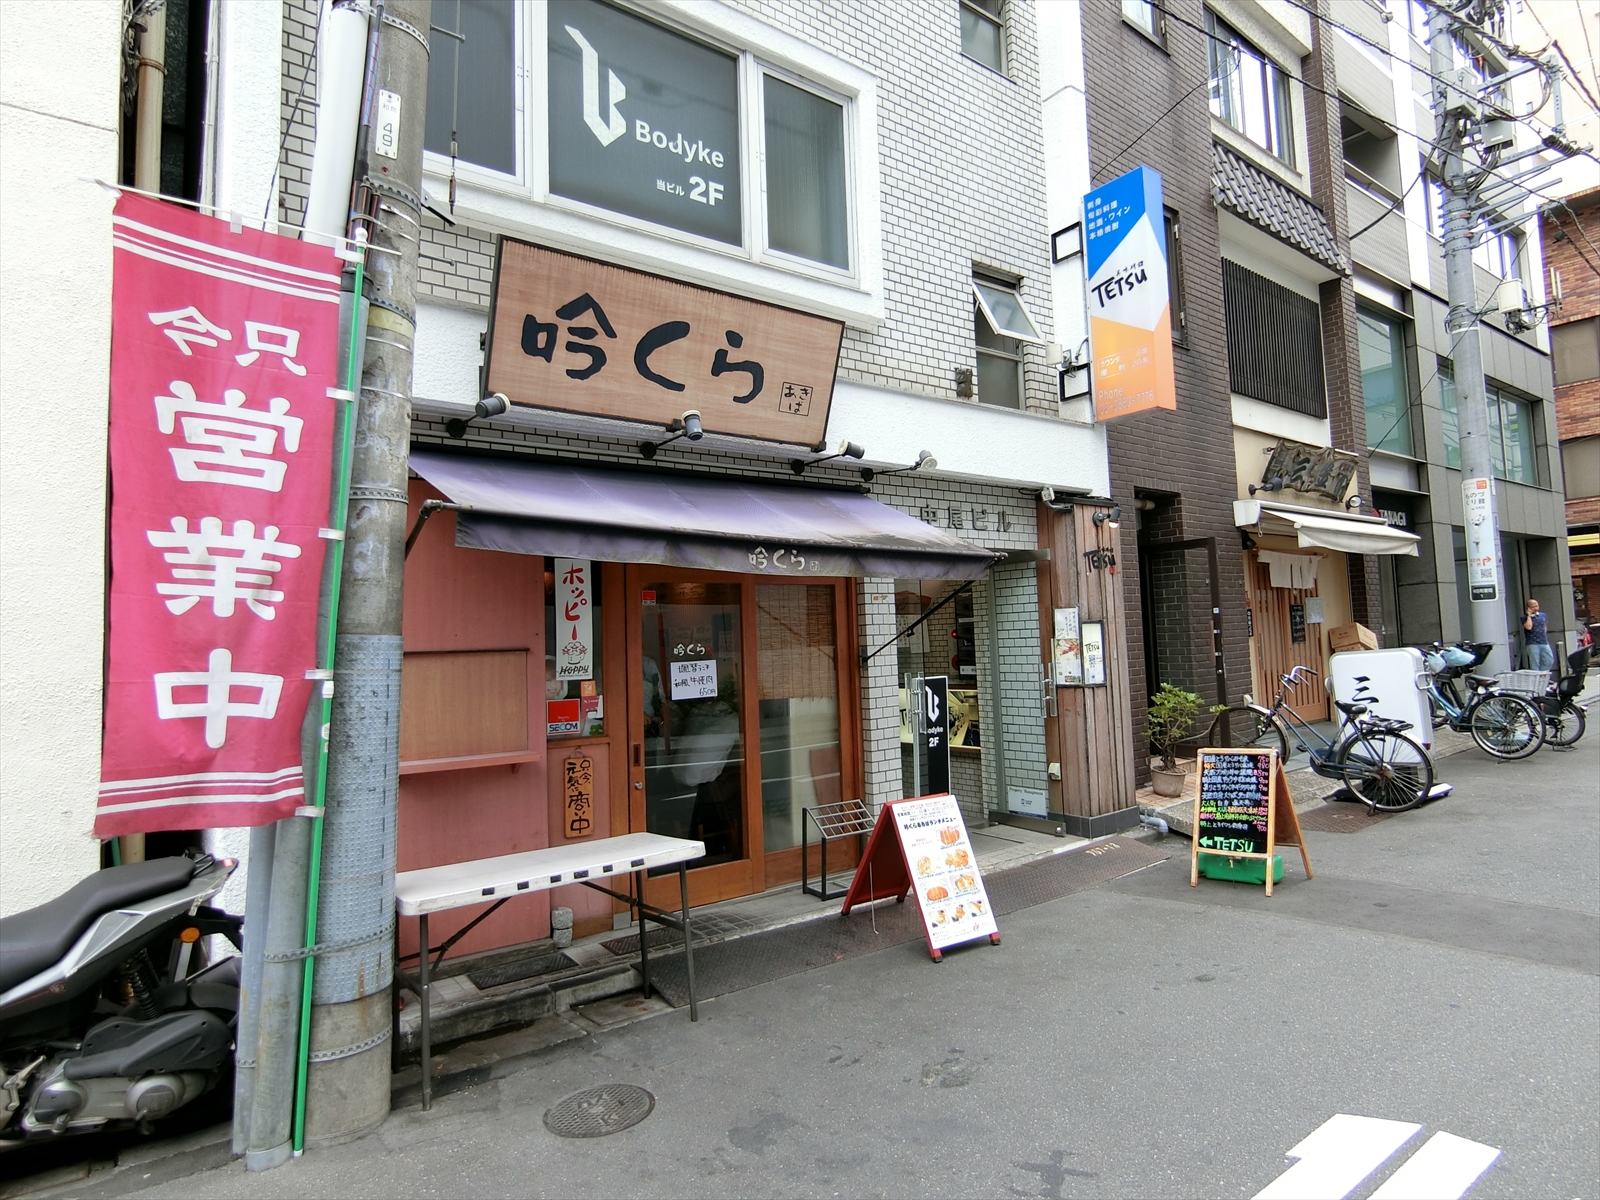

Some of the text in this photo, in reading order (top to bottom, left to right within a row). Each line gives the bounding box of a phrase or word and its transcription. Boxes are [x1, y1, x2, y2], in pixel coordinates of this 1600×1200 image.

[382, 122, 393, 147] 49
[635, 119, 725, 168] Bodyke
[656, 176, 725, 206] 当ビル 2F
[1091, 268, 1148, 308] TETSU
[521, 292, 765, 404] 吟くら
[1099, 387, 1124, 399] Phone
[920, 503, 1013, 533] 中尾ビル
[748, 545, 806, 570] 吟くら
[562, 562, 588, 641] ホッピー
[673, 643, 706, 656] 吟くら
[549, 722, 578, 732] SECOM
[928, 736, 940, 747] 2F
[1213, 836, 1254, 853] TETSU
